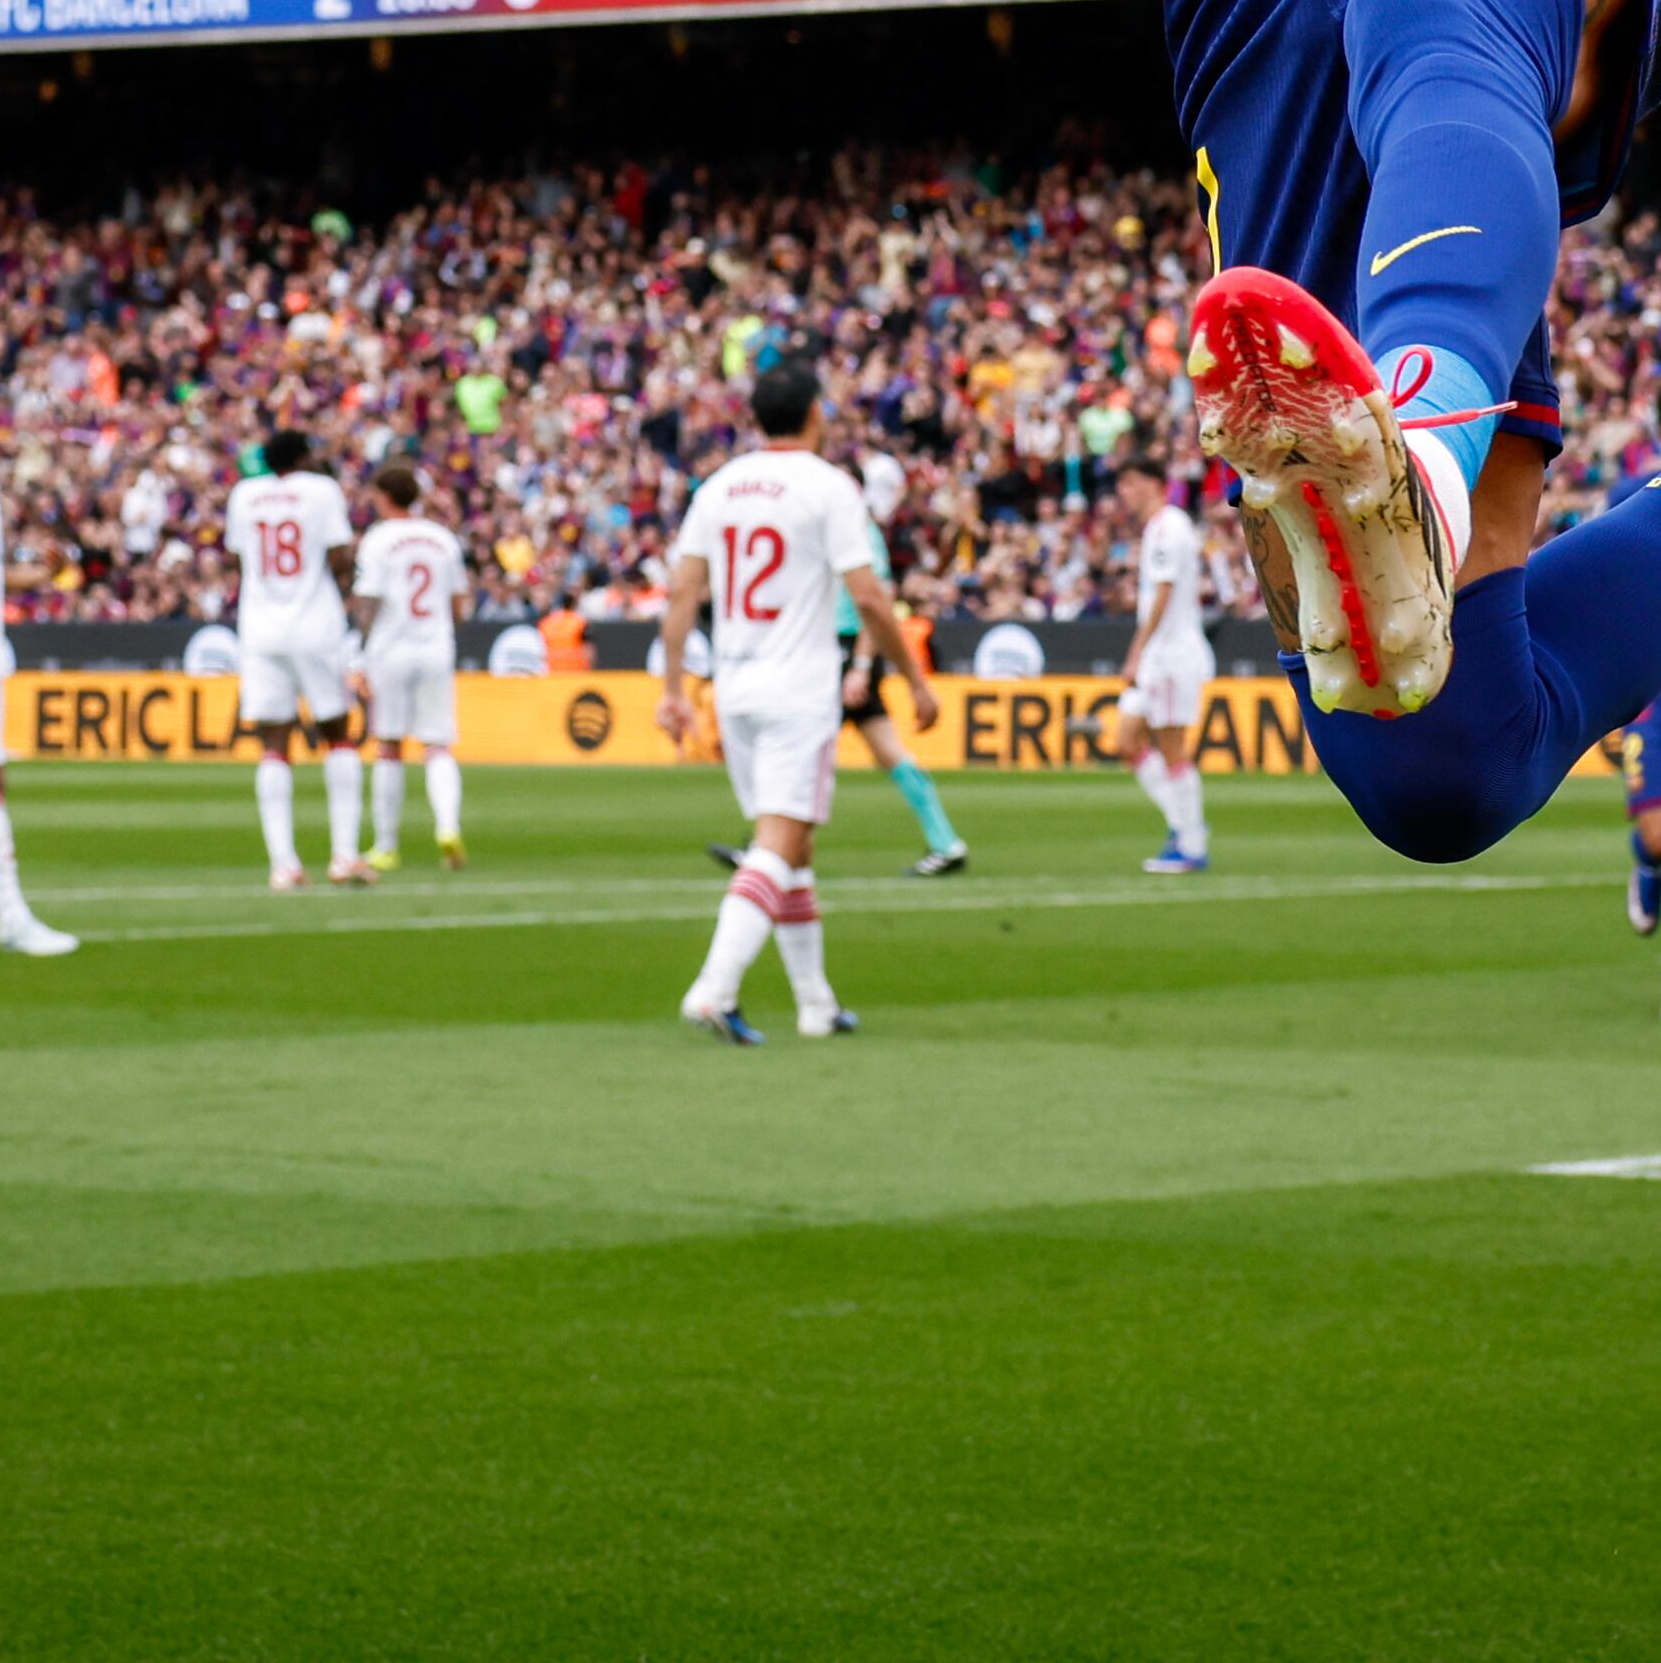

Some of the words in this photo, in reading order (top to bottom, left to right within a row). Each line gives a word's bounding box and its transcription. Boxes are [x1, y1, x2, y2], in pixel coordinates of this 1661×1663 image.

[257, 520, 302, 578] 18
[722, 525, 787, 622] 12
[409, 562, 432, 619] 2
